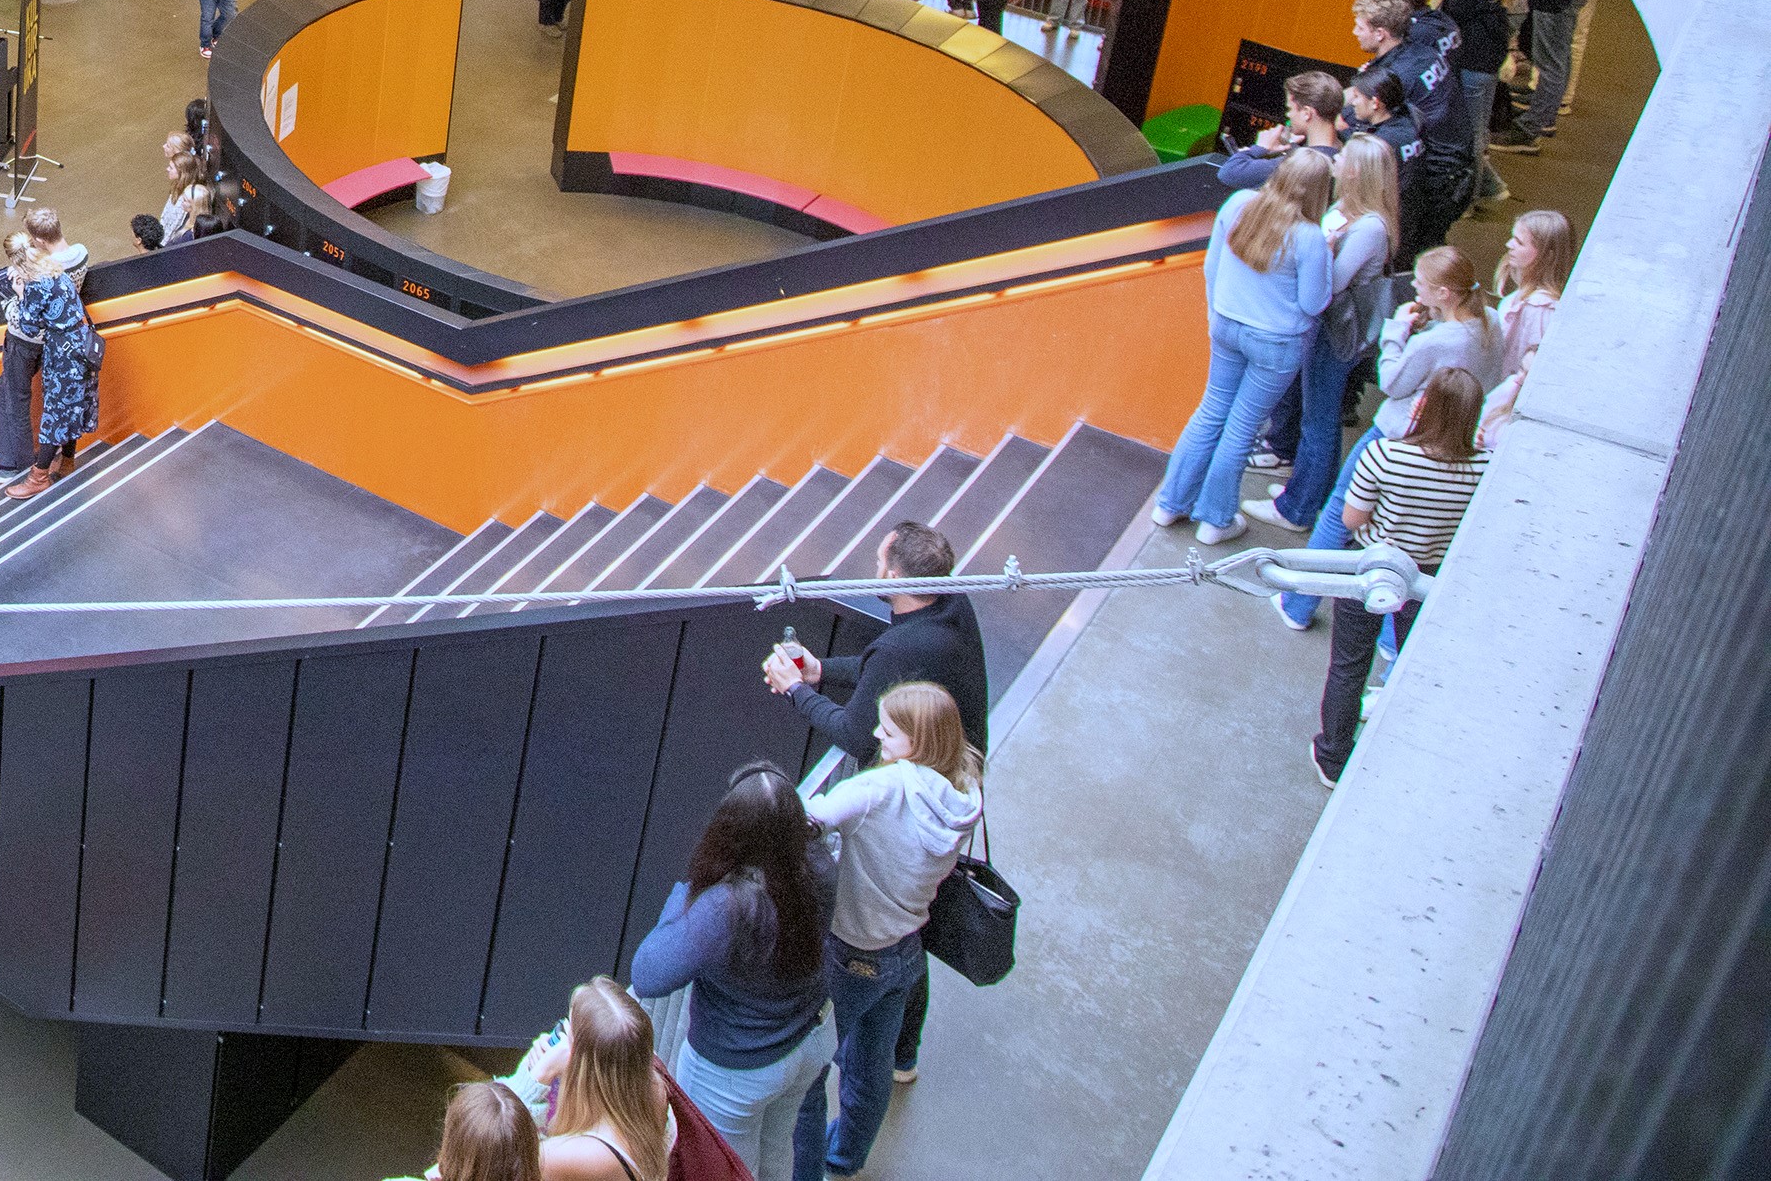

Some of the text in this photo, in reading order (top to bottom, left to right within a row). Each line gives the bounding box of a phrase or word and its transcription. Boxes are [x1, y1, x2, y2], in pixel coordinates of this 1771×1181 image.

[242, 178, 257, 198] 2049
[323, 240, 345, 261] 2057
[403, 279, 430, 300] 2065
